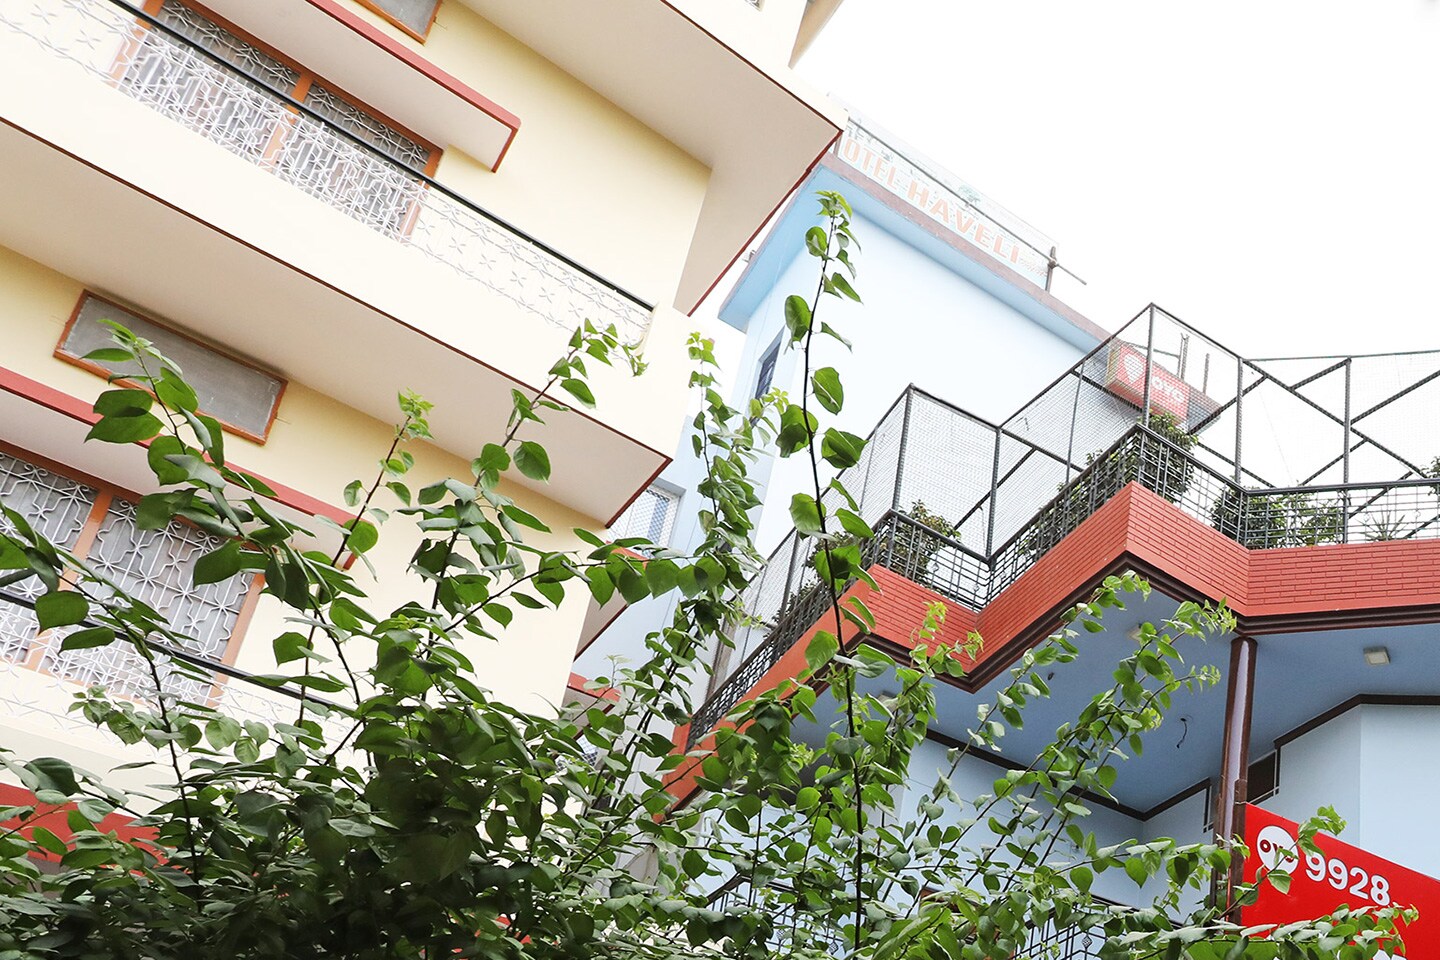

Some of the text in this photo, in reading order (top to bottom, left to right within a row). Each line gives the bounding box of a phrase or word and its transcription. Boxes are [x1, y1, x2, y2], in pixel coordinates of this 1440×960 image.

[843, 137, 1020, 265] OTEL HAVELI
[1305, 852, 1391, 906] 9928
